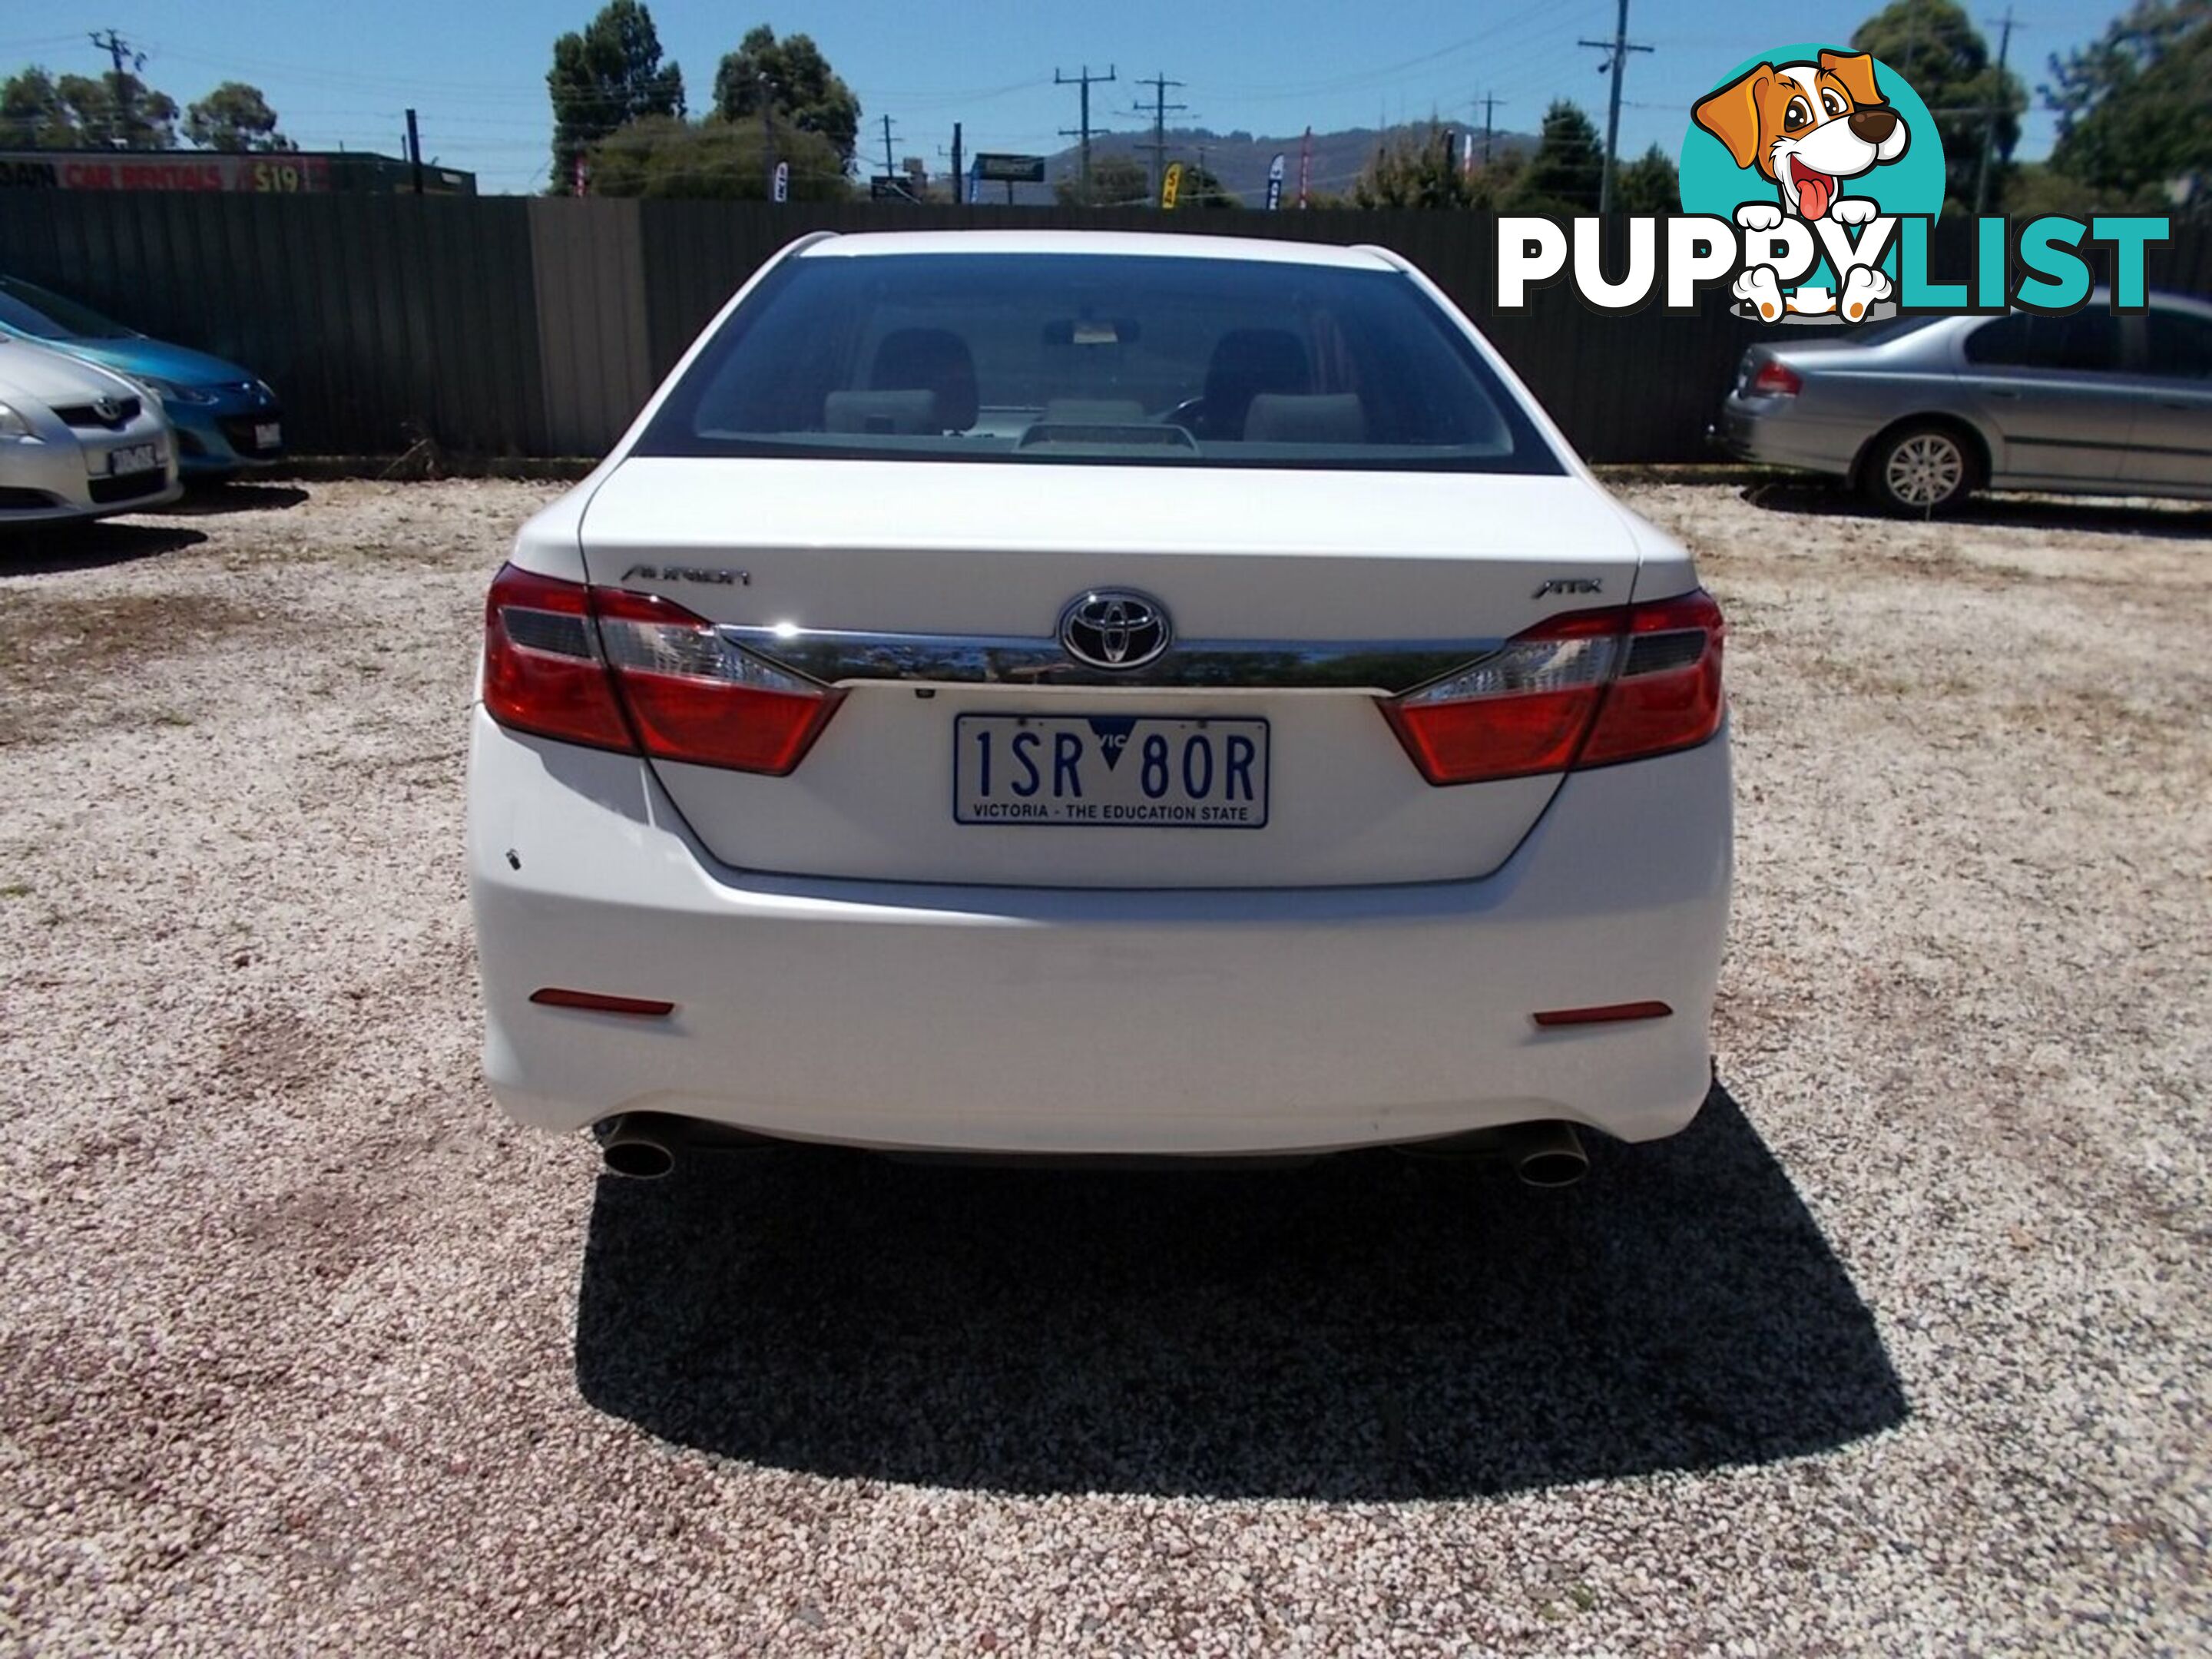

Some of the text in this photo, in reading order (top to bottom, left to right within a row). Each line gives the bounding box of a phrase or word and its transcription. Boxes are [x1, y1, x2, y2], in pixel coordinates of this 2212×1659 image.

[67, 164, 112, 190] CAR
[122, 164, 224, 191] RENTALS
[254, 162, 299, 194] $19
[620, 565, 751, 585] AURION
[976, 731, 1084, 798] 1SR
[973, 803, 1048, 817] VICTORIA
[1066, 804, 1097, 818] THE
[1104, 805, 1195, 820] EDUCATION
[1201, 807, 1248, 821] STATE
